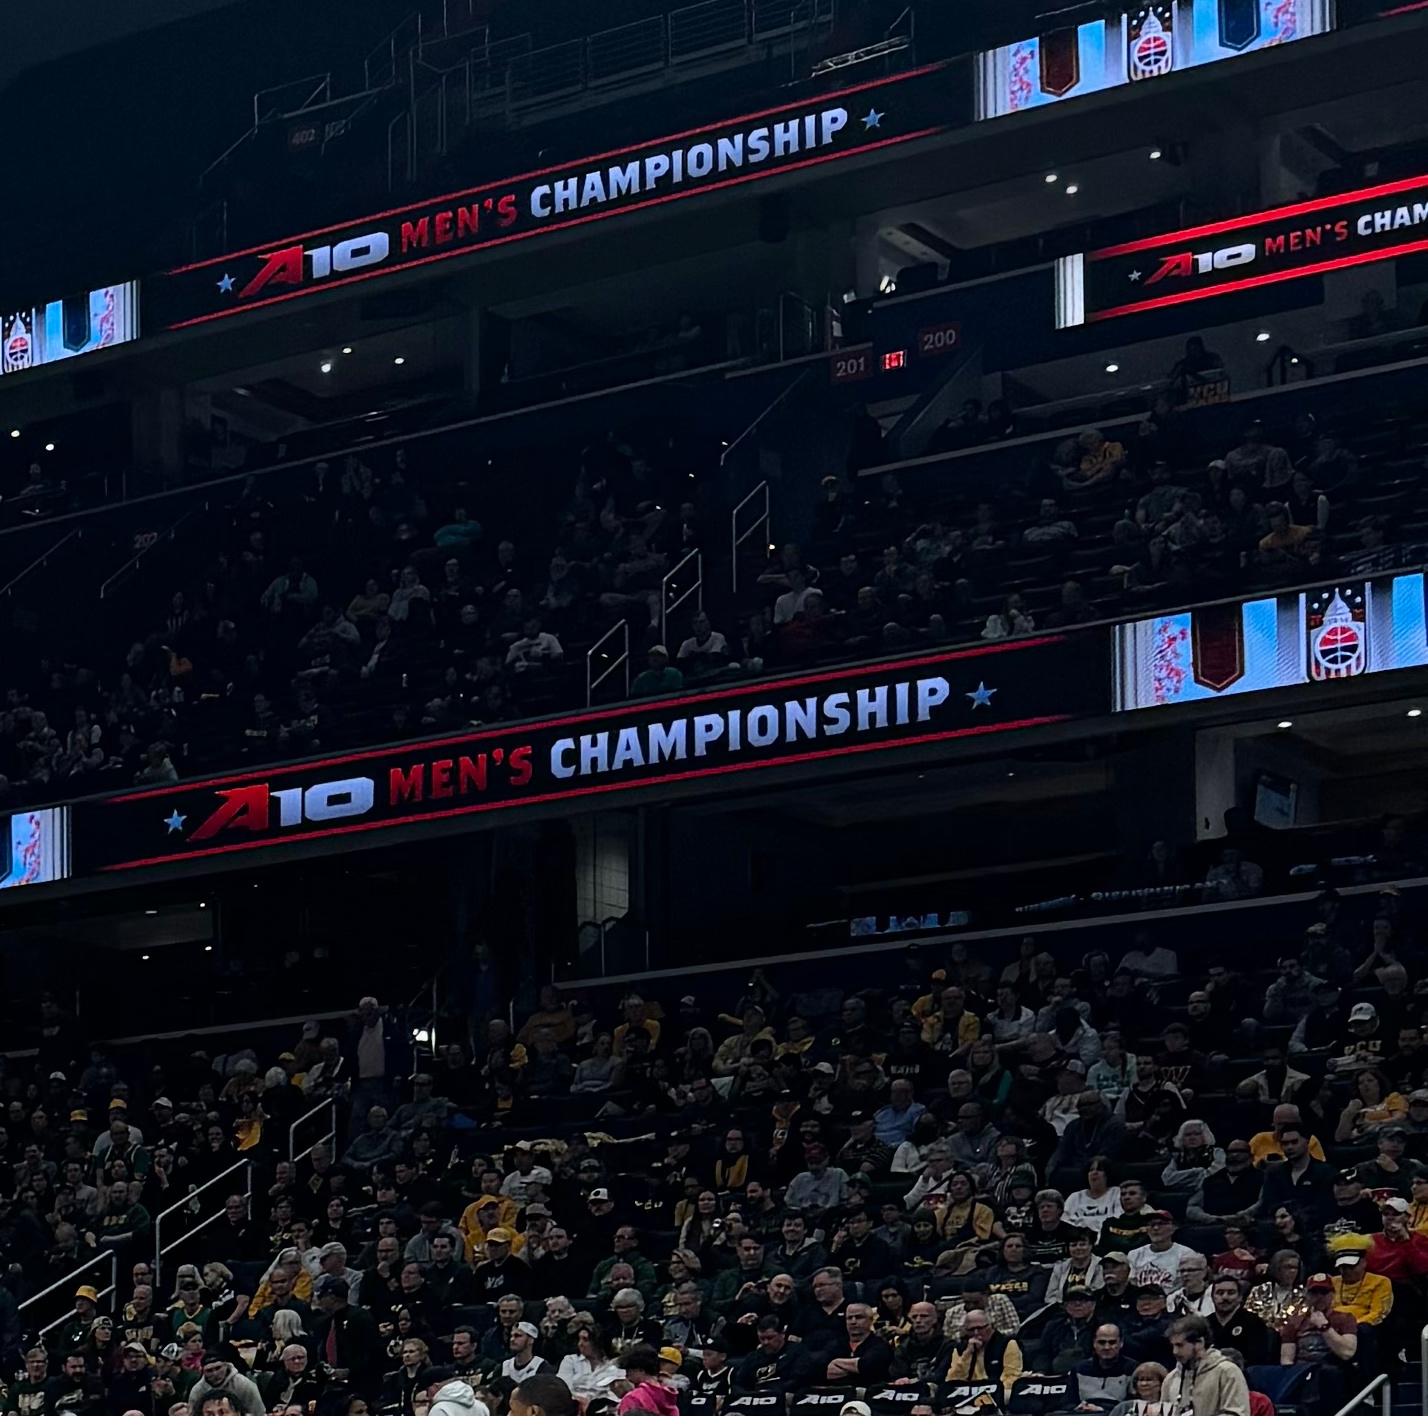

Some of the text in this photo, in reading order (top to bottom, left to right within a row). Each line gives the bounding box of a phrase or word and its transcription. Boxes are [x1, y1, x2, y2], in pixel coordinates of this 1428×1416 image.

[238, 107, 849, 299] A10 MEN'S CHAMPIONSHIP
[1144, 242, 1256, 286] A10
[1264, 219, 1350, 258] MEN'S
[835, 356, 867, 379] 201
[922, 327, 957, 351] 200
[188, 677, 950, 843] A10 MEN'S CHAMPIONSHIP
